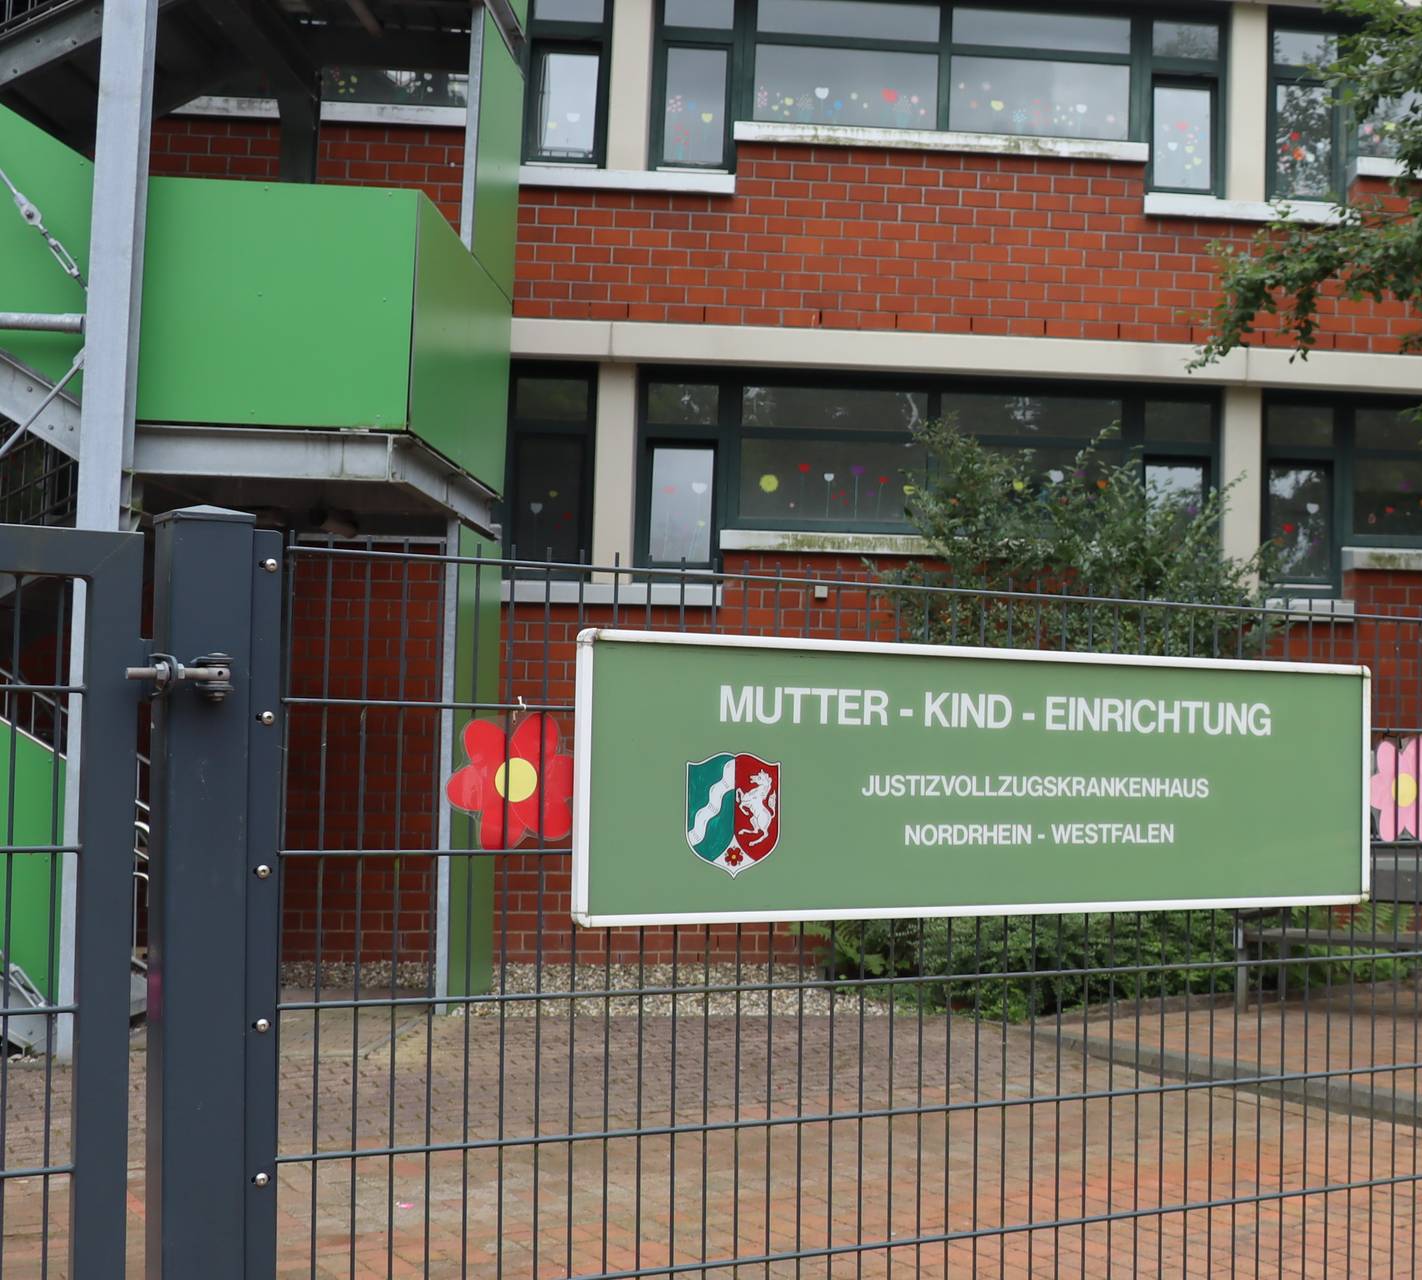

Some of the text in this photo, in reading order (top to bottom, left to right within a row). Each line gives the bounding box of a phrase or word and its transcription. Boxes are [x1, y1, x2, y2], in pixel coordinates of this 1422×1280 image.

[719, 684, 890, 727] MUTTER
[923, 691, 1013, 730] KIND
[1044, 695, 1274, 737] EINRICHTUNG
[861, 774, 1210, 799] JUSTIZVOLLZUGSKRANKENHAUS
[904, 823, 1033, 847] NORDRHEIN
[1050, 822, 1175, 846] WESTFALEN
